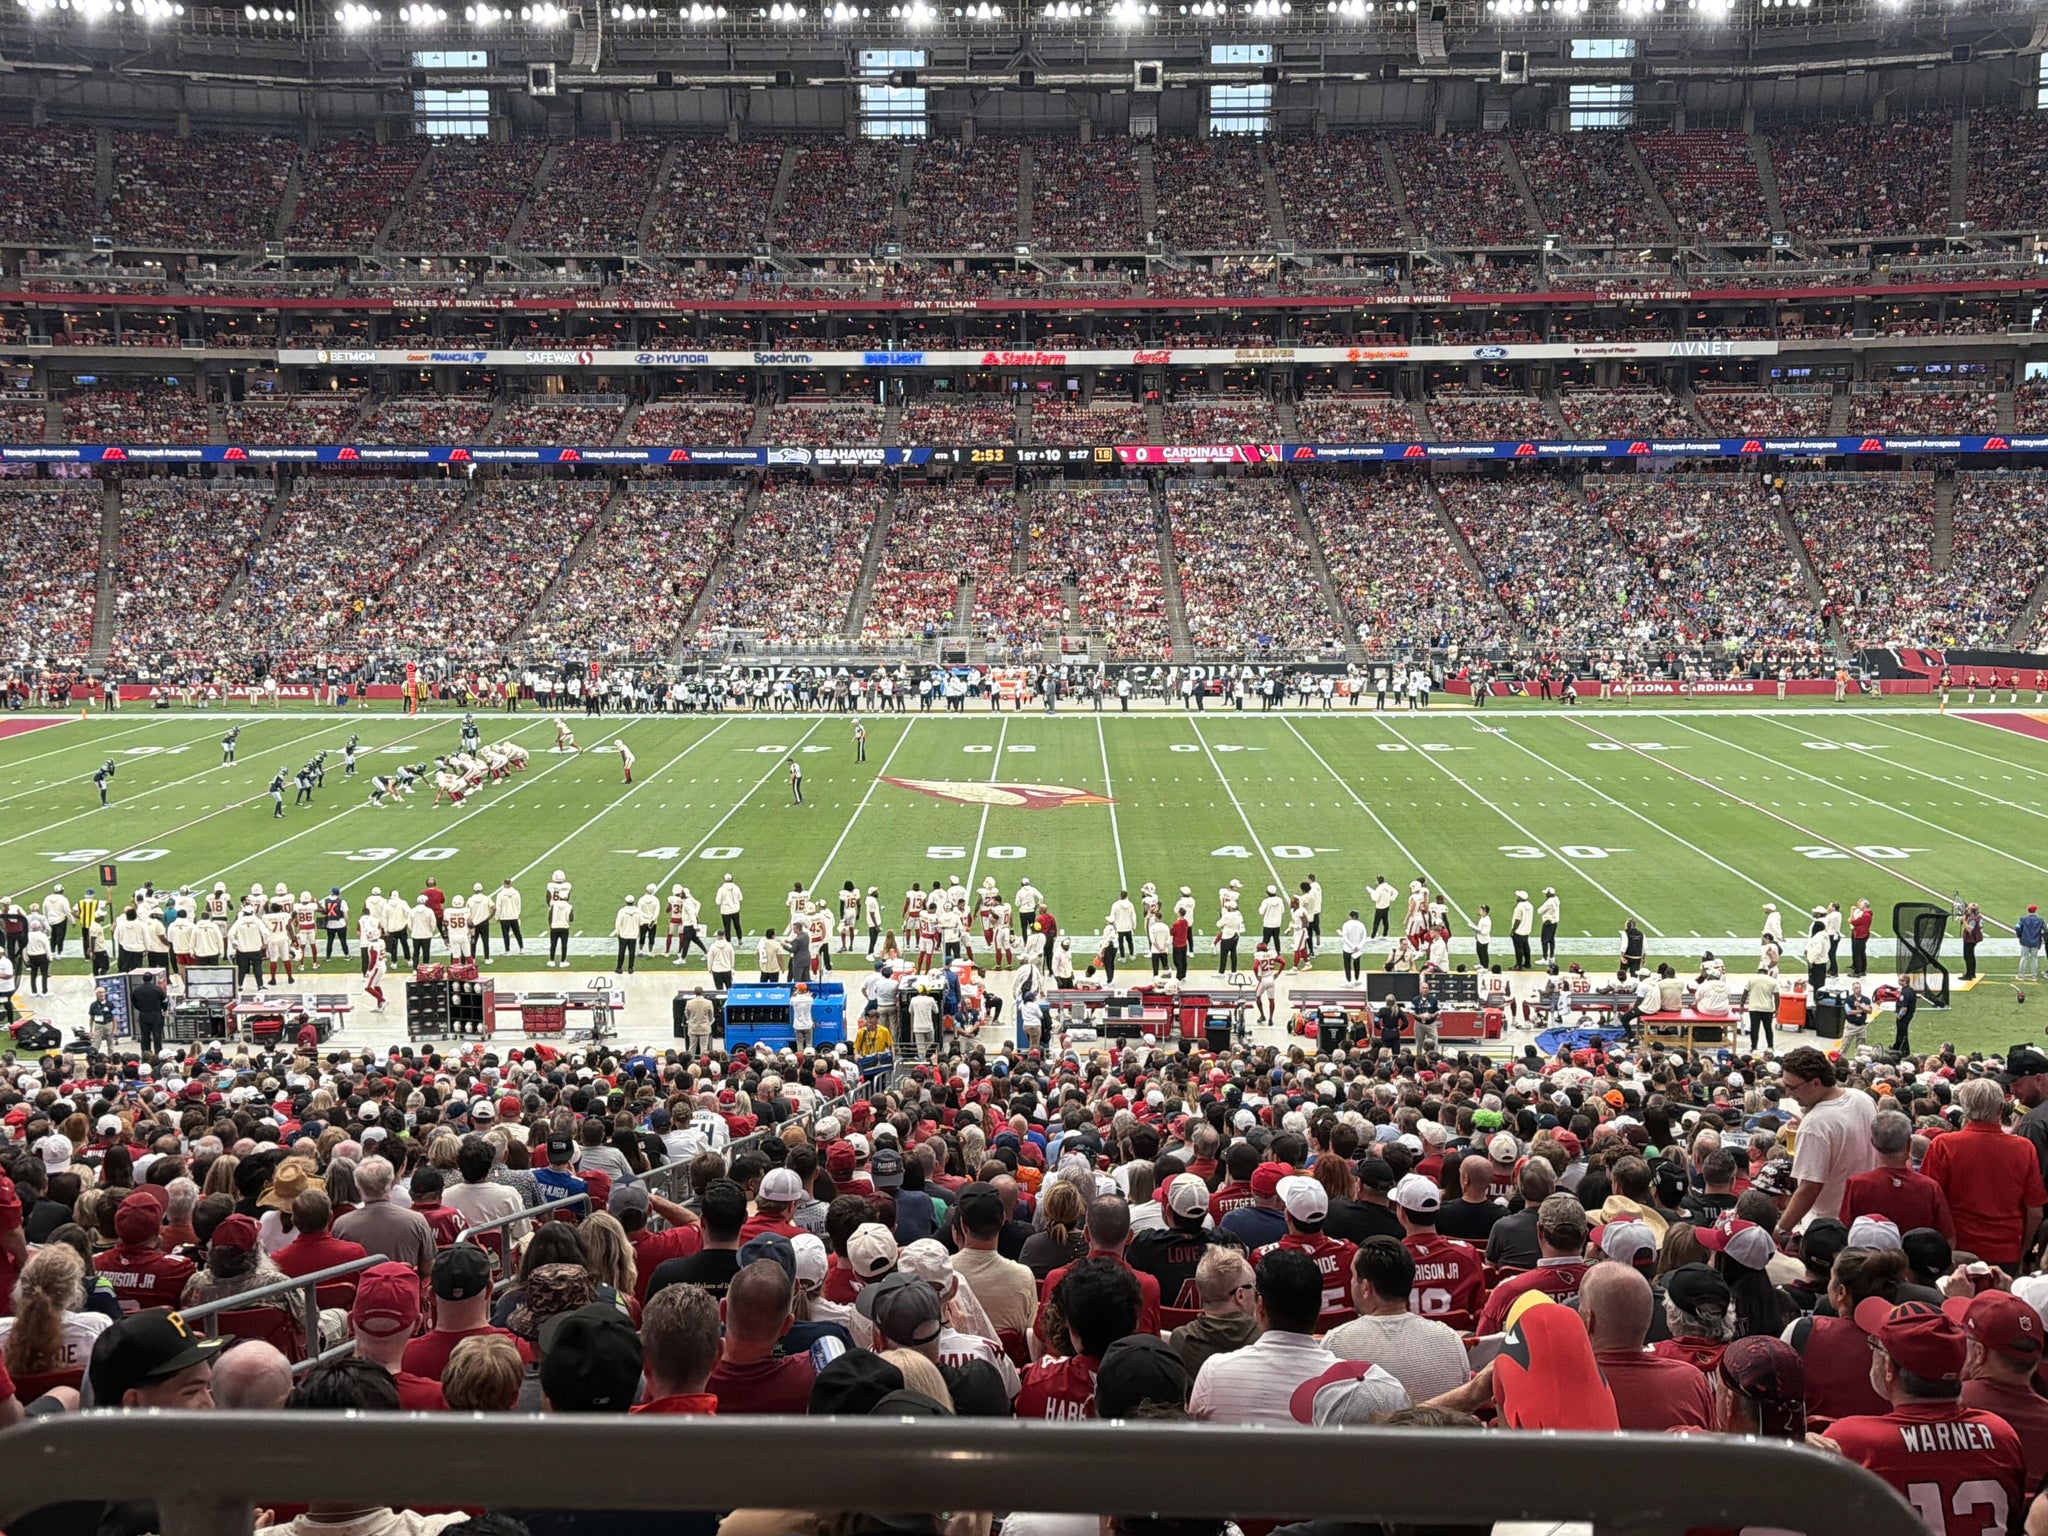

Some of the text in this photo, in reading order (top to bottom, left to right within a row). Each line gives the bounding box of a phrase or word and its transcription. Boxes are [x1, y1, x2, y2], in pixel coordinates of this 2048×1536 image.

[1377, 296, 1410, 304] ROGER
[1610, 292, 1656, 300] CHARLEY
[393, 300, 438, 308] CHARLES
[441, 300, 454, 308] W.
[455, 301, 499, 309] BIDWILL,
[1235, 350, 1295, 358] GILA RIVER
[1477, 346, 1507, 360] Ford
[1671, 341, 1734, 355] AVNET
[331, 352, 376, 361] BETMGM
[430, 353, 469, 361] FINANCIAL
[526, 352, 577, 363] SAFEWAY
[656, 353, 709, 363] HYUNDAI
[753, 352, 808, 365] Spectrum
[864, 353, 923, 364] BUD LIGHT
[1001, 352, 1066, 364] State Farm
[814, 449, 912, 462] SEAHAWKS 7
[953, 450, 960, 462] 1
[971, 450, 1004, 462] 2:53
[1017, 450, 1037, 461] 1ST
[1046, 449, 1061, 460] 10
[1077, 450, 1089, 459] 27
[1097, 451, 1109, 459] 18
[1136, 447, 1234, 461] 0 CARDINALS
[50, 849, 171, 862] 20
[346, 848, 460, 861] 30
[637, 847, 745, 860] 40
[925, 846, 1028, 859] 50
[1210, 845, 1315, 859] 40
[1498, 845, 1611, 859] 30
[1791, 845, 1911, 859] 20
[104, 866, 112, 881] 1
[211, 900, 224, 912] 18
[327, 902, 338, 917] K
[912, 898, 923, 909] 13
[271, 920, 284, 933] 71
[449, 917, 466, 929] 58
[1489, 978, 1502, 991] 10
[266, 1057, 274, 1070] 3
[1168, 1245, 1199, 1262] LOVE
[1447, 1262, 1459, 1280] JR
[139, 1273, 155, 1290] JR
[167, 1311, 187, 1338] P
[1899, 1423, 1996, 1454] WARNER
